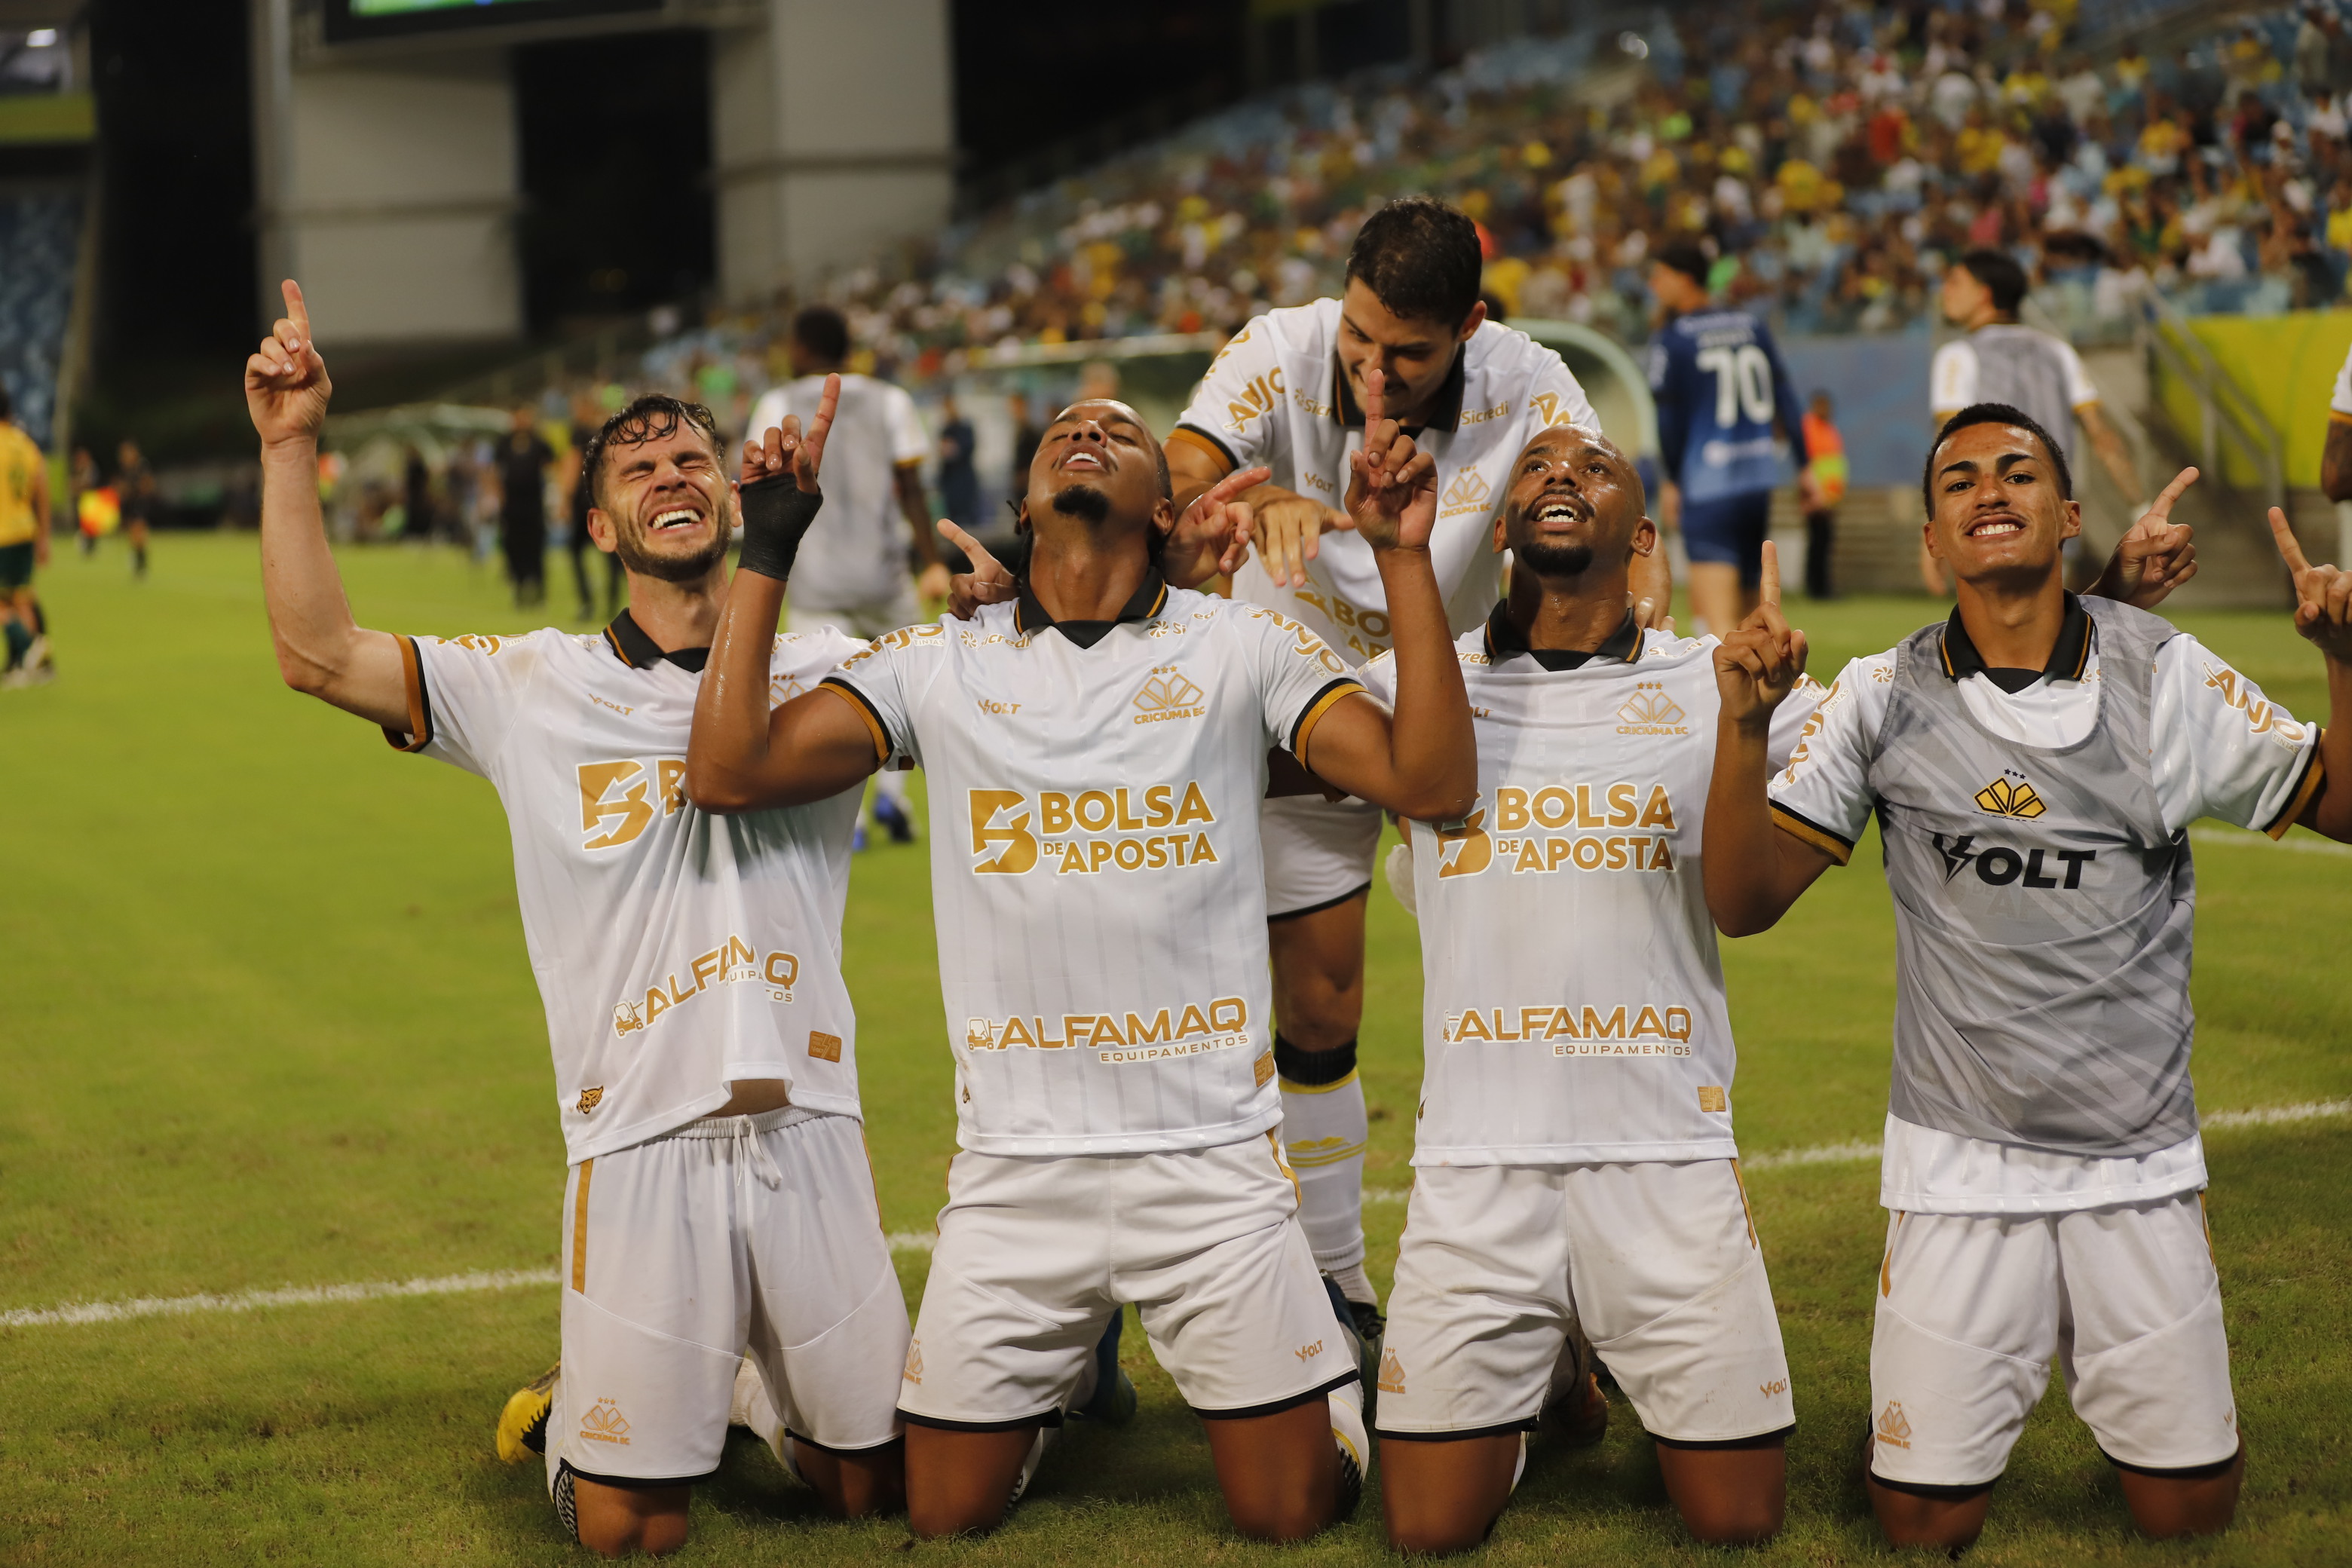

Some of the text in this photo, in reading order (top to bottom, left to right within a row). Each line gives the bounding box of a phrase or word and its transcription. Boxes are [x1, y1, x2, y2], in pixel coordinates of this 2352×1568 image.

[1696, 346, 1775, 428] 70
[1304, 399, 1332, 417] Sicr
[1460, 401, 1508, 425] Sicredi
[1304, 472, 1333, 492] VOLT
[588, 693, 634, 716] VOLT
[978, 699, 1021, 715] VOLT
[1801, 690, 1821, 700] TINT
[1825, 688, 1850, 714] TINTAS
[1193, 706, 1205, 717] EC
[1674, 726, 1689, 735] EC
[1040, 781, 1214, 835] BOLSA
[1496, 784, 1677, 831] BOLSA
[1043, 831, 1219, 874] DE APOSTA
[1498, 837, 1675, 872] DE APOSTA
[1931, 832, 2097, 890] VOLT
[997, 997, 1247, 1050] ALFAMAQ
[1453, 1006, 1692, 1043] ALFAMAQ
[1100, 1034, 1249, 1062] EQUIPAMENTOS
[1554, 1045, 1692, 1056] EQUIPAMENTOS
[1294, 1339, 1324, 1364] VOLT
